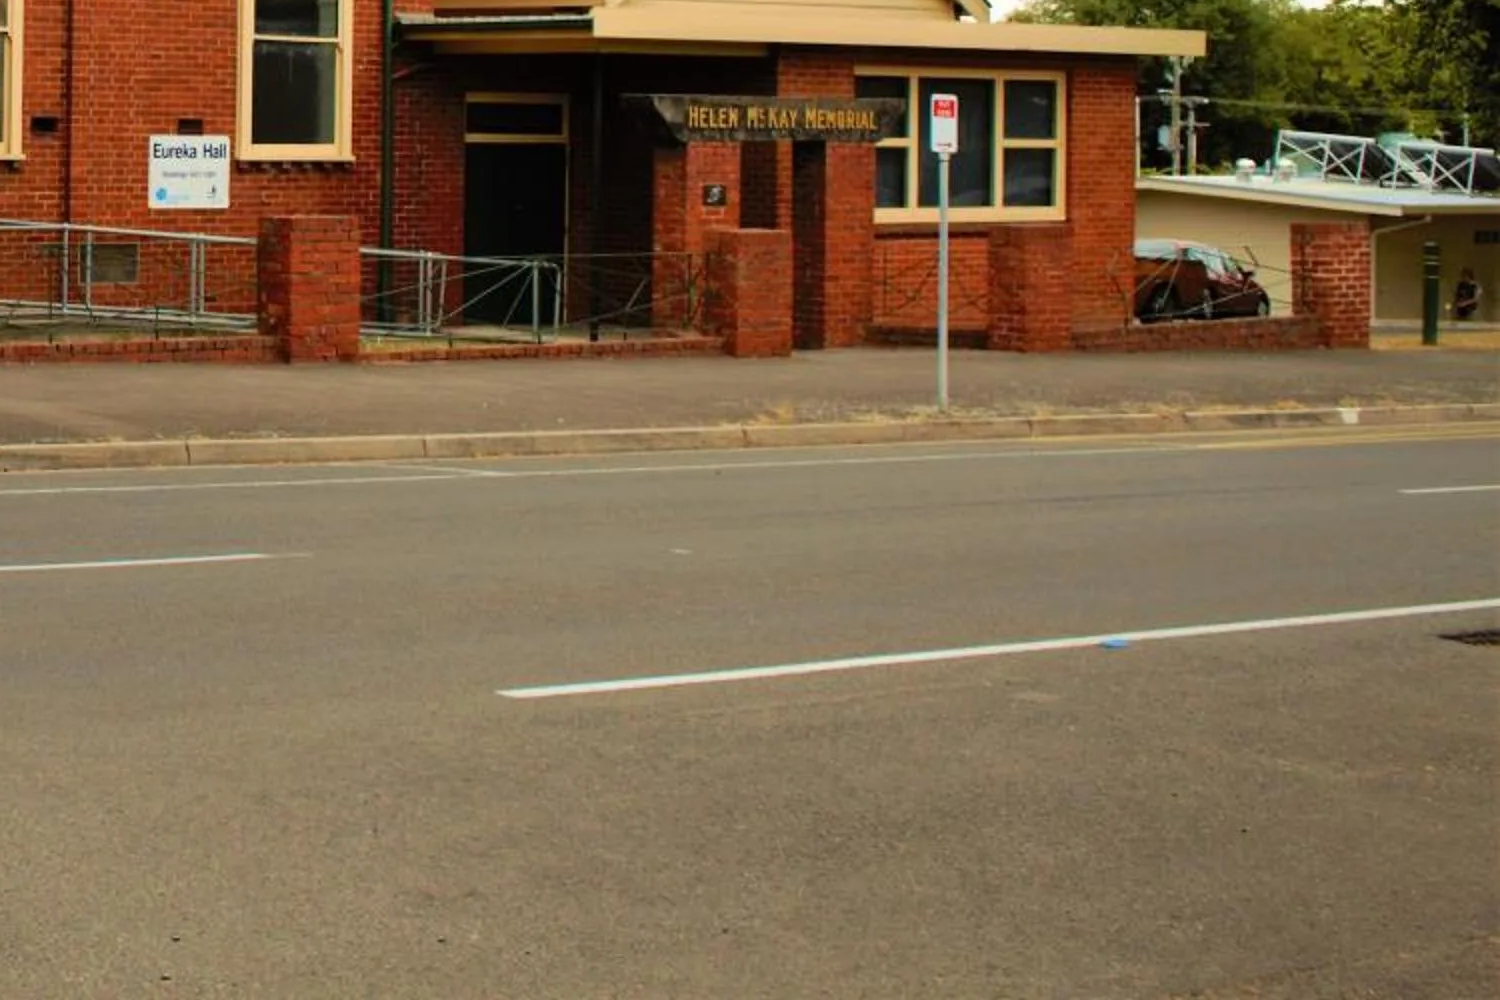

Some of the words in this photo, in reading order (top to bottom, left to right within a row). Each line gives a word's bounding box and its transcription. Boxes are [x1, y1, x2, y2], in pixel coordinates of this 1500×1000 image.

[689, 105, 739, 128] HELEN
[806, 106, 877, 129] MEMORIAL
[153, 143, 197, 159] Eureka
[203, 143, 227, 159] Hall
